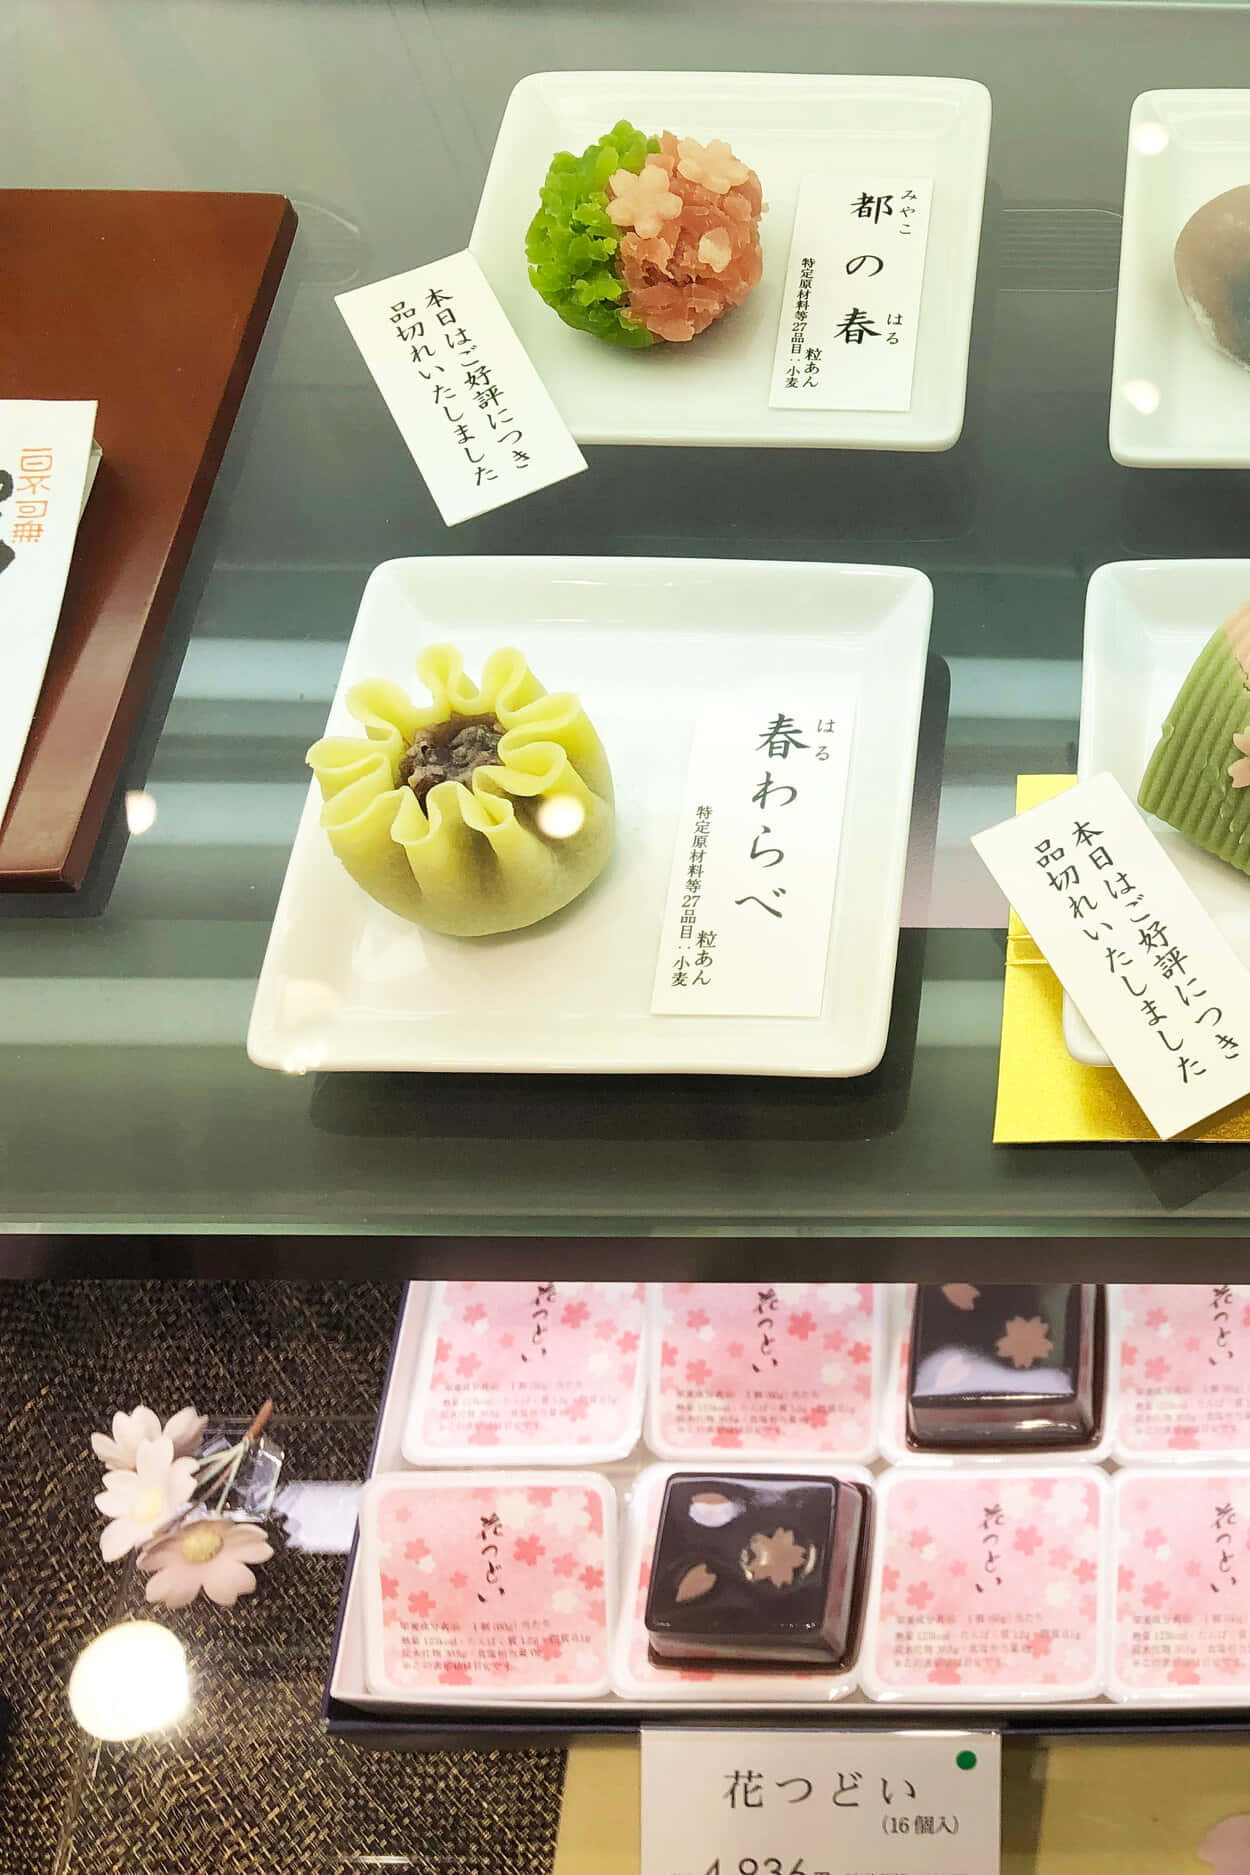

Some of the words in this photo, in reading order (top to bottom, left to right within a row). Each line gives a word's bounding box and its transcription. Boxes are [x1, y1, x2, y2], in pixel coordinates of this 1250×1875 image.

[899, 190, 918, 235] みやこ
[833, 191, 895, 345] 都の春
[802, 347, 823, 388] 粒あん
[886, 313, 904, 345] はる
[389, 300, 498, 486] 品切れいたしました
[425, 288, 531, 469] 本日はご好評につき
[815, 718, 836, 761] はる
[735, 713, 811, 919] 春わらべ
[692, 930, 718, 986] 粒あん
[1034, 839, 1207, 1084] 品切れいたしました
[1072, 820, 1241, 1060] 本日はご好評につき
[752, 1288, 779, 1374] 花つどい
[1208, 1285, 1234, 1367] 花つどい
[475, 1512, 505, 1604] 花つどい
[975, 1504, 1005, 1594] 花つどい
[1210, 1503, 1237, 1594] 花つどい
[723, 1770, 917, 1809] 花つどい
